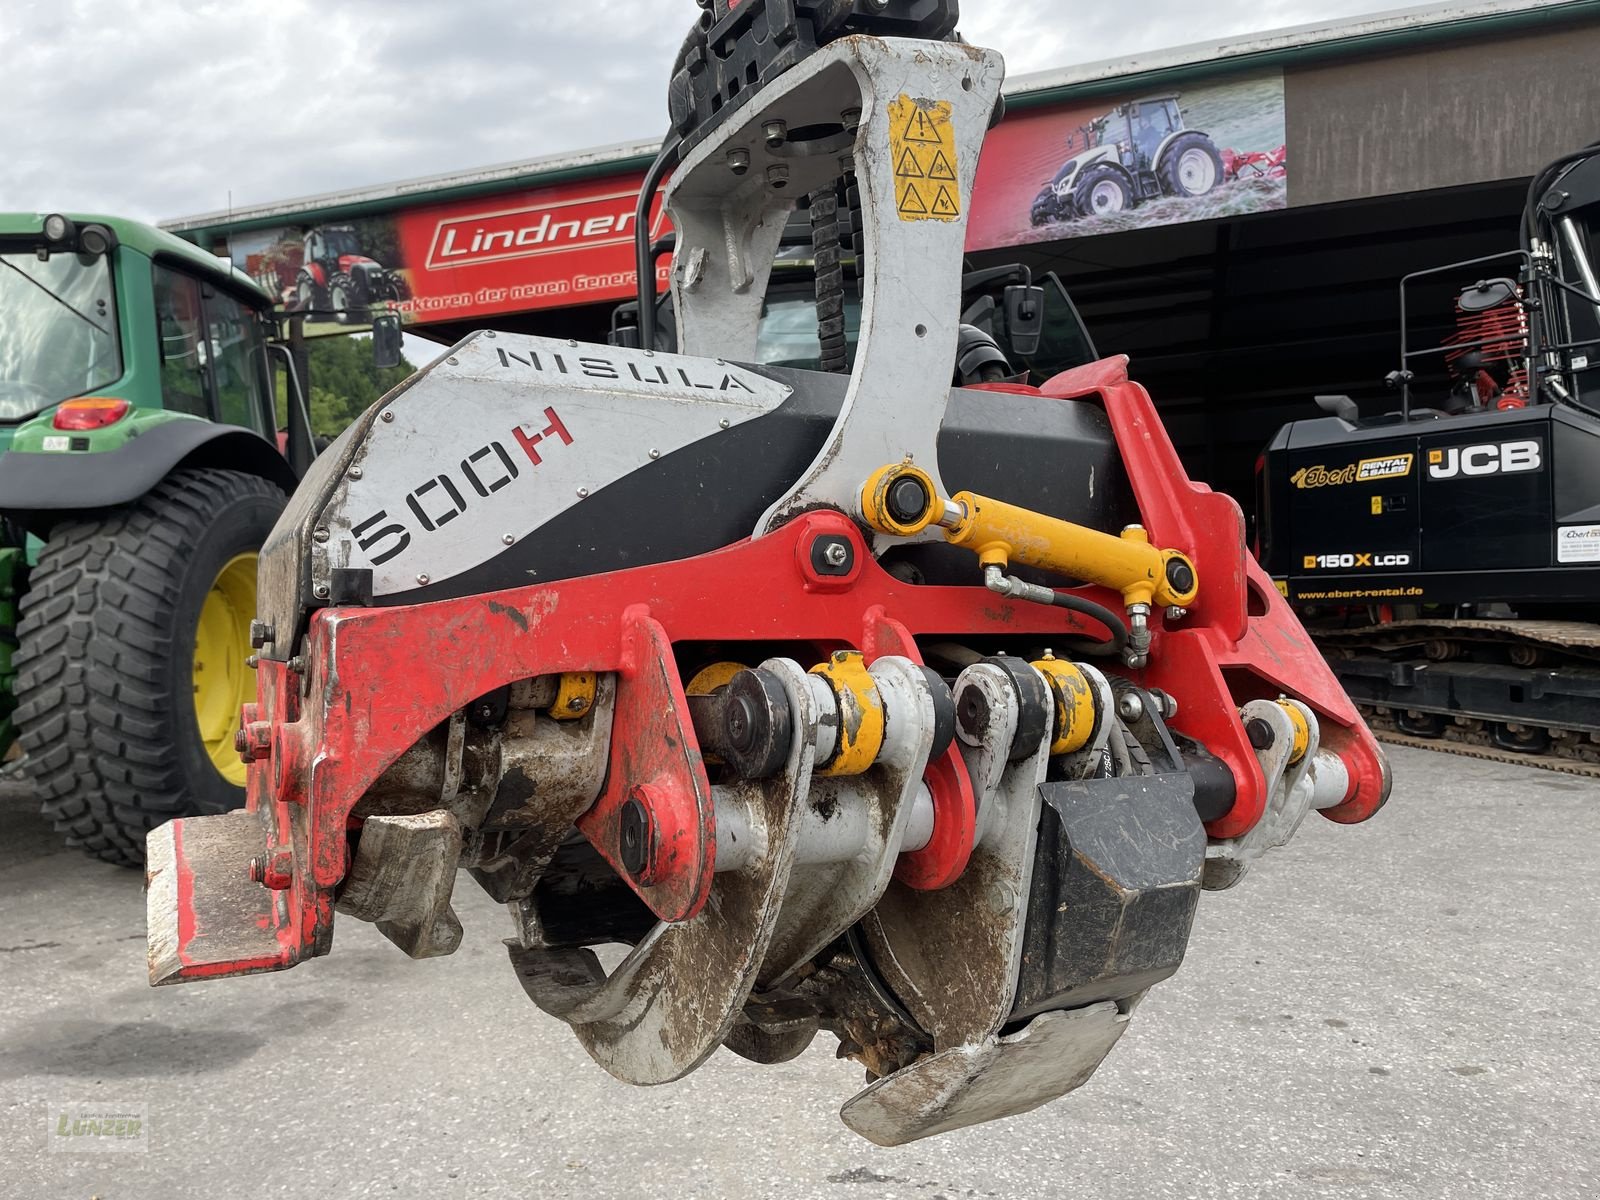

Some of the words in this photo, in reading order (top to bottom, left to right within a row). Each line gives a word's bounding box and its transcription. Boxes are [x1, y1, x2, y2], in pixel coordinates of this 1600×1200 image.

[441, 211, 637, 257] Lindner
[386, 291, 473, 314] Traktoren
[475, 288, 507, 304] der
[510, 279, 569, 299] neuen
[495, 347, 756, 395] NISULA
[1304, 464, 1357, 488] Ebert
[1361, 458, 1408, 471] RENTAL
[1430, 441, 1541, 478] JCB
[350, 406, 575, 567] 500H
[1374, 554, 1410, 567] LCD
[1298, 587, 1424, 599] www.ebert-rental.de
